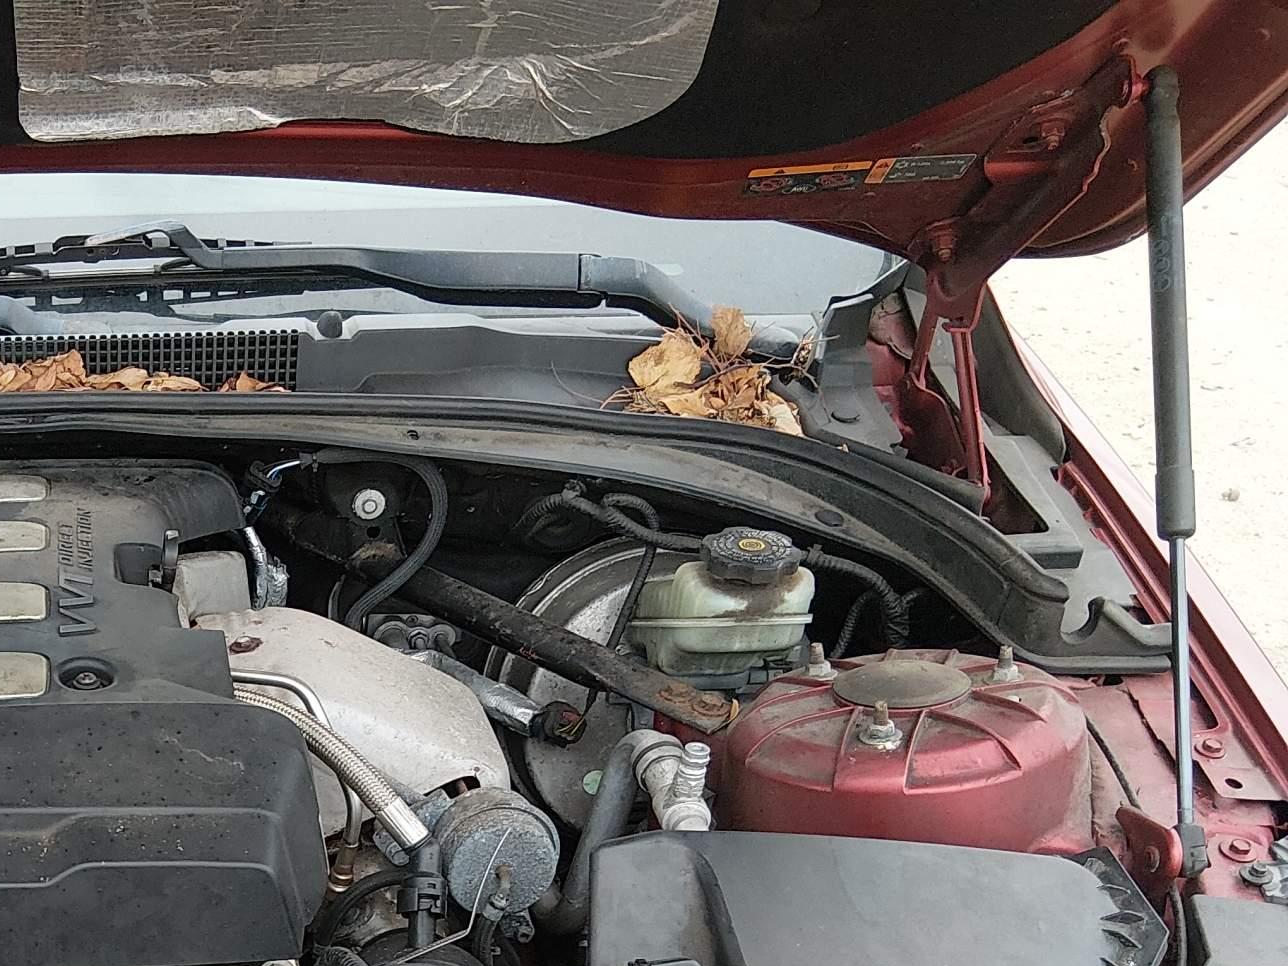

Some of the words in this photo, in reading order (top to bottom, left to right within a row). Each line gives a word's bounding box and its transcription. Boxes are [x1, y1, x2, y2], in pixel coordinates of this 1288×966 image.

[57, 521, 74, 567] DIRECT
[76, 507, 94, 571] INJECTION
[57, 567, 97, 638] VVT
